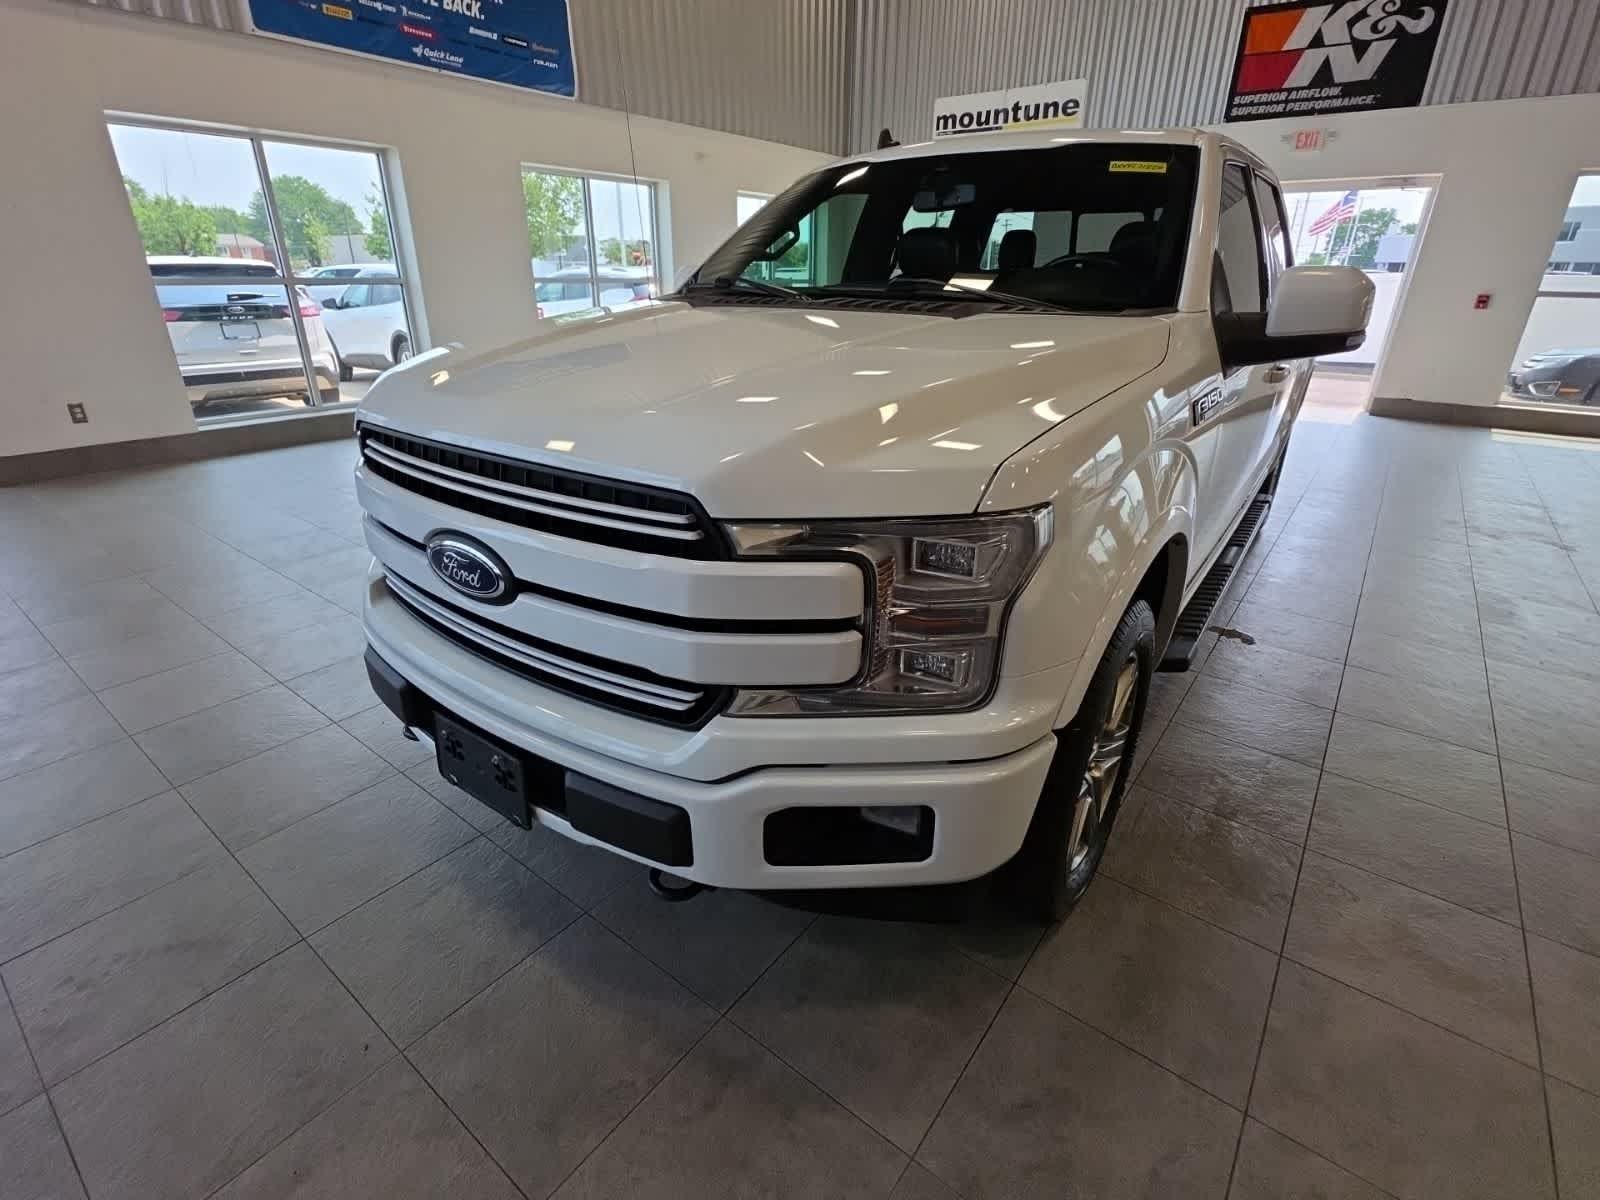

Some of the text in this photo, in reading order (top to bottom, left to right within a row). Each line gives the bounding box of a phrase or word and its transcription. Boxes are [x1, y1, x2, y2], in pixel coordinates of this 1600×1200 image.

[443, 0, 485, 20] BACK.
[424, 47, 445, 59] Quick
[446, 52, 464, 64] Lane
[1233, 86, 1343, 105] SUPERIOR AIRFLOW.
[935, 98, 1080, 131] mountune
[1231, 102, 1285, 116] SUPERIOR
[1296, 131, 1321, 150] EXIT
[441, 551, 481, 588] Ford
